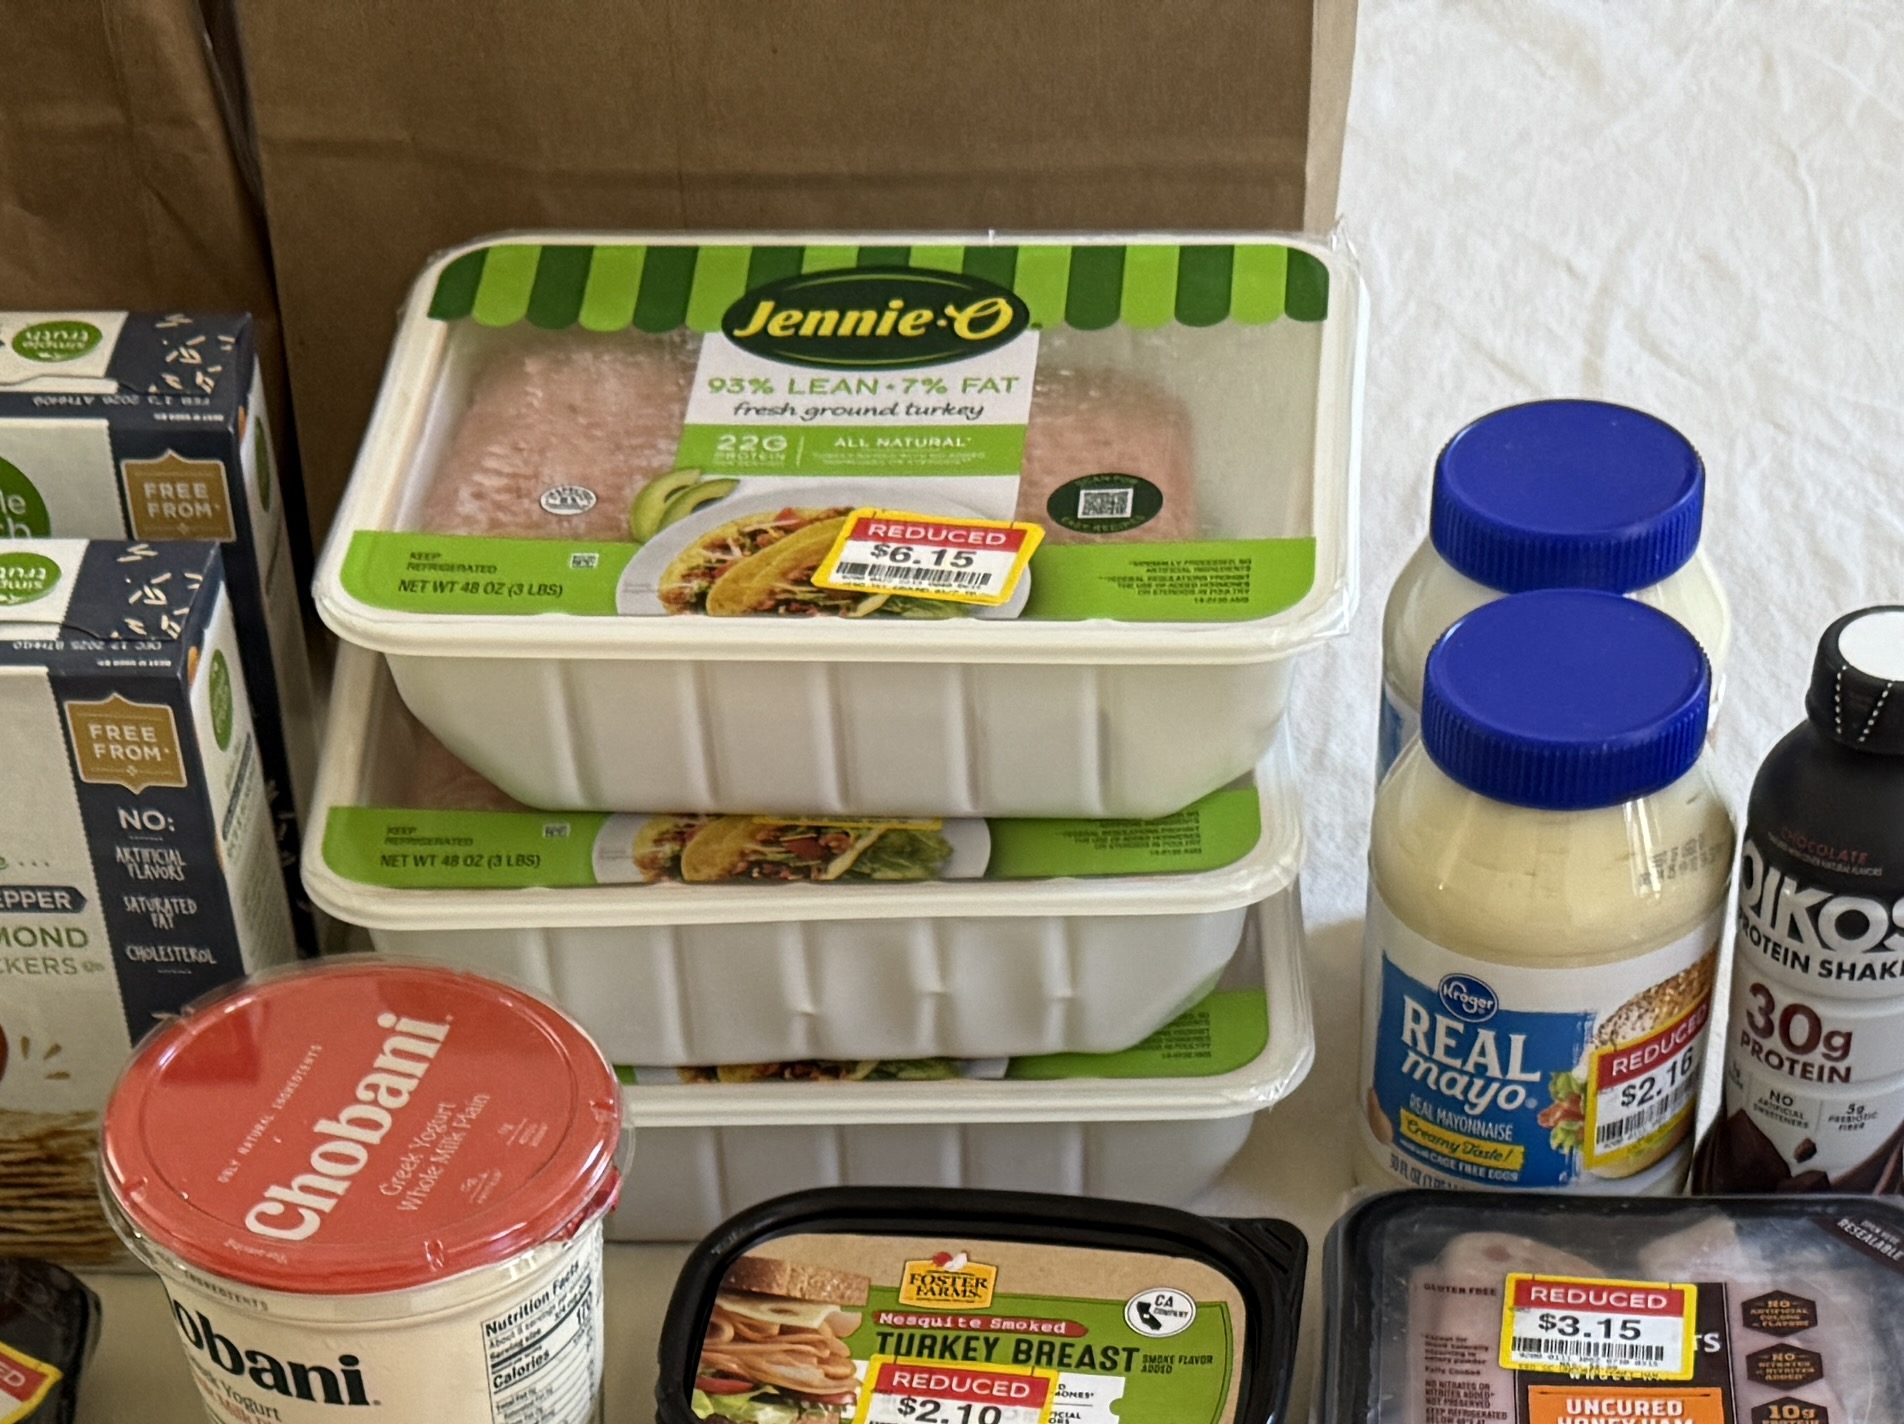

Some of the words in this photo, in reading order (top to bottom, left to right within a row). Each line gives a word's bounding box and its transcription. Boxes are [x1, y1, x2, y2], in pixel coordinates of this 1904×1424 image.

[730, 296, 1015, 342] Jennie-O
[707, 377, 776, 396] 93%
[788, 377, 880, 396] LEAN
[904, 377, 948, 395] 7%
[961, 377, 1019, 394] FAT
[732, 399, 796, 420] fresh
[798, 402, 900, 422] ground
[903, 399, 984, 422] turkey
[867, 522, 1007, 546] REDUCED
[870, 544, 977, 568] $6.15
[1442, 980, 1494, 1014] Kroger
[1401, 994, 1541, 1082] REAL
[1611, 1004, 1709, 1076] REDUCED
[1747, 982, 1854, 1063] 30g
[1741, 1031, 1852, 1084] PROTEIN
[1401, 1051, 1527, 1116] mayo
[1620, 1046, 1693, 1108] $2.16
[244, 1012, 452, 1242] Chobani
[380, 1160, 428, 1198] Greek
[414, 1101, 456, 1166] Yogurt
[908, 1272, 988, 1293] FOSTER
[1530, 1286, 1668, 1310] REDUCED
[879, 1313, 984, 1332] Mesquite
[989, 1318, 1067, 1335] Smoked
[1538, 1312, 1642, 1342] $3.15
[492, 1349, 551, 1388] Calories
[876, 1331, 1001, 1364] TURKEY
[1012, 1339, 1140, 1374] BREAST
[893, 1371, 1031, 1399] REDUCED
[1565, 1398, 1684, 1417] UNCURED
